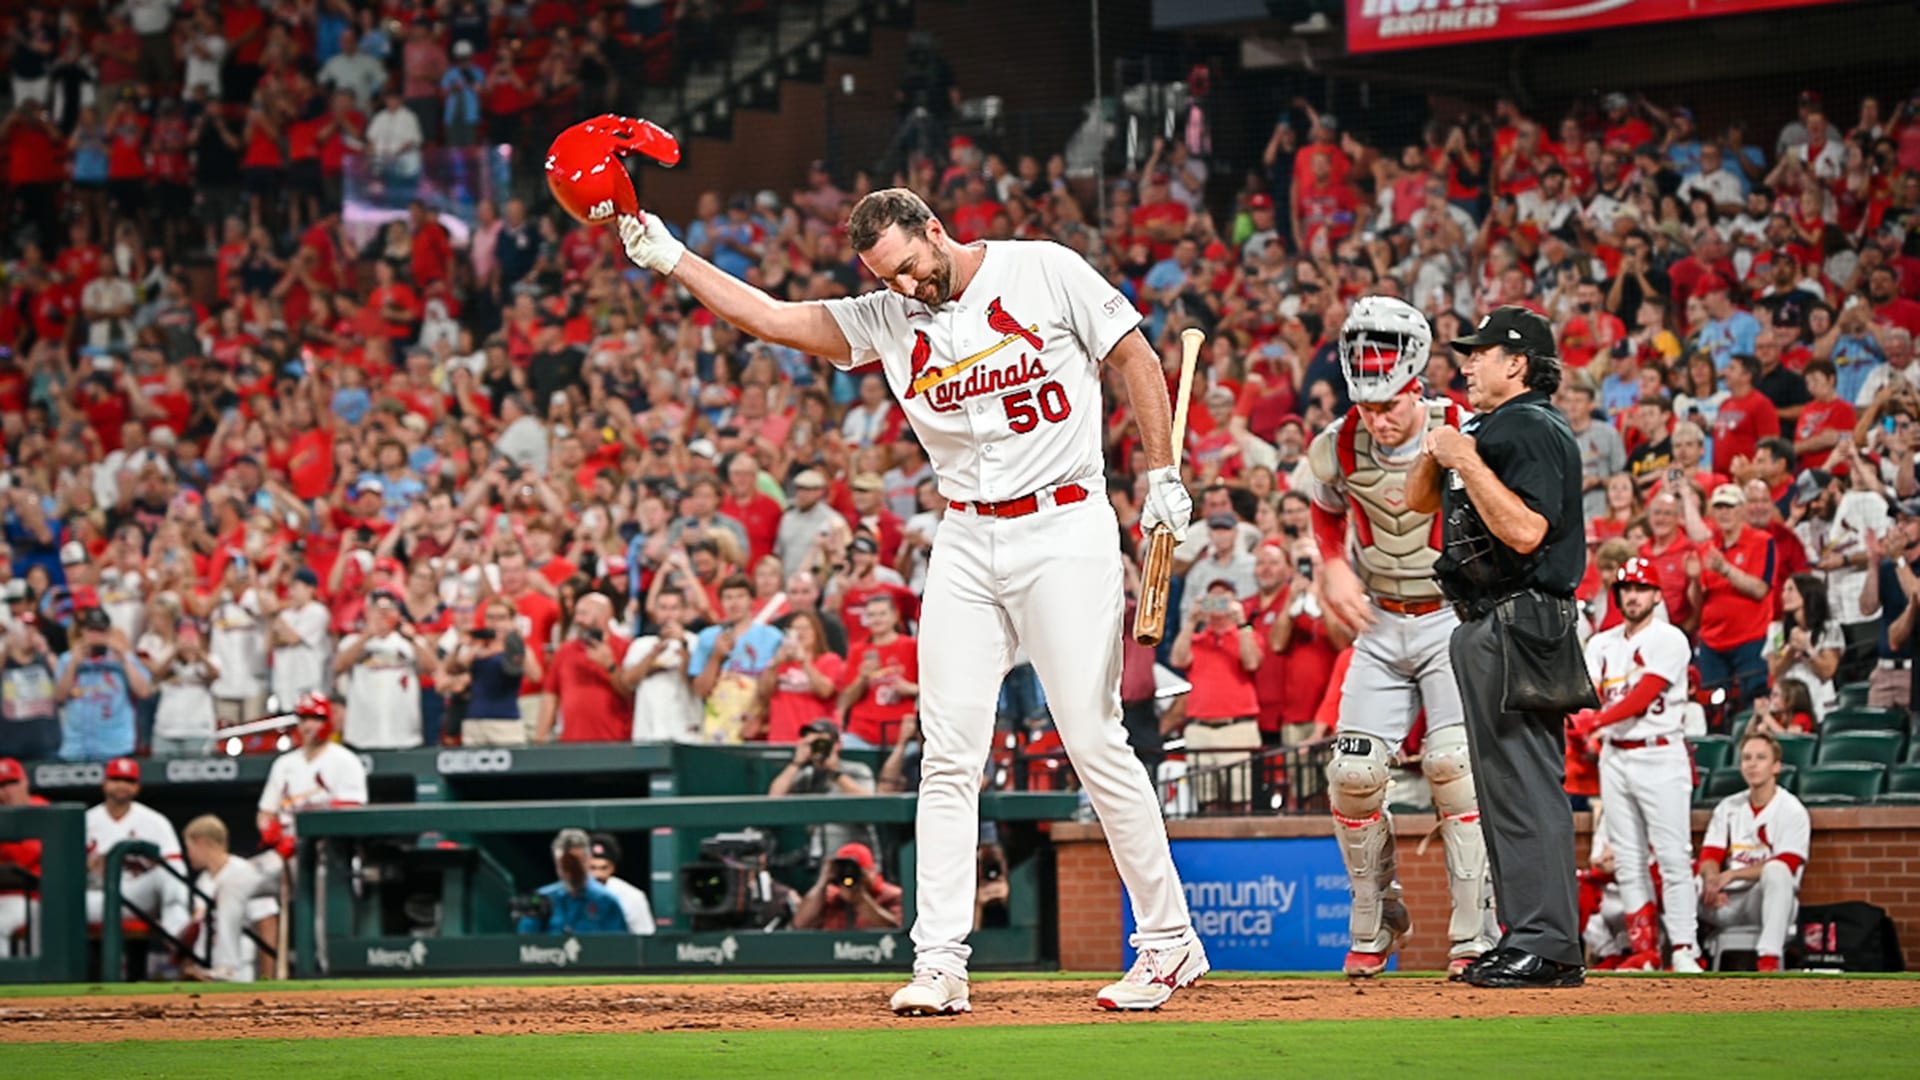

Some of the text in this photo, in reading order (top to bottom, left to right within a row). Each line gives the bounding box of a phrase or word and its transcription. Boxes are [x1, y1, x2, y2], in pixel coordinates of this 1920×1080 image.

[1378, 5, 1499, 38] BROTHERS
[924, 353, 1049, 412] Cardinals
[1001, 380, 1072, 434] 50
[167, 759, 238, 781] GEICO
[437, 750, 512, 773] GEICO
[36, 764, 104, 787] GEICO
[367, 948, 412, 969] Mercy
[519, 946, 567, 967] Mercy
[677, 943, 723, 965] Mercy
[834, 941, 881, 963] Mercy
